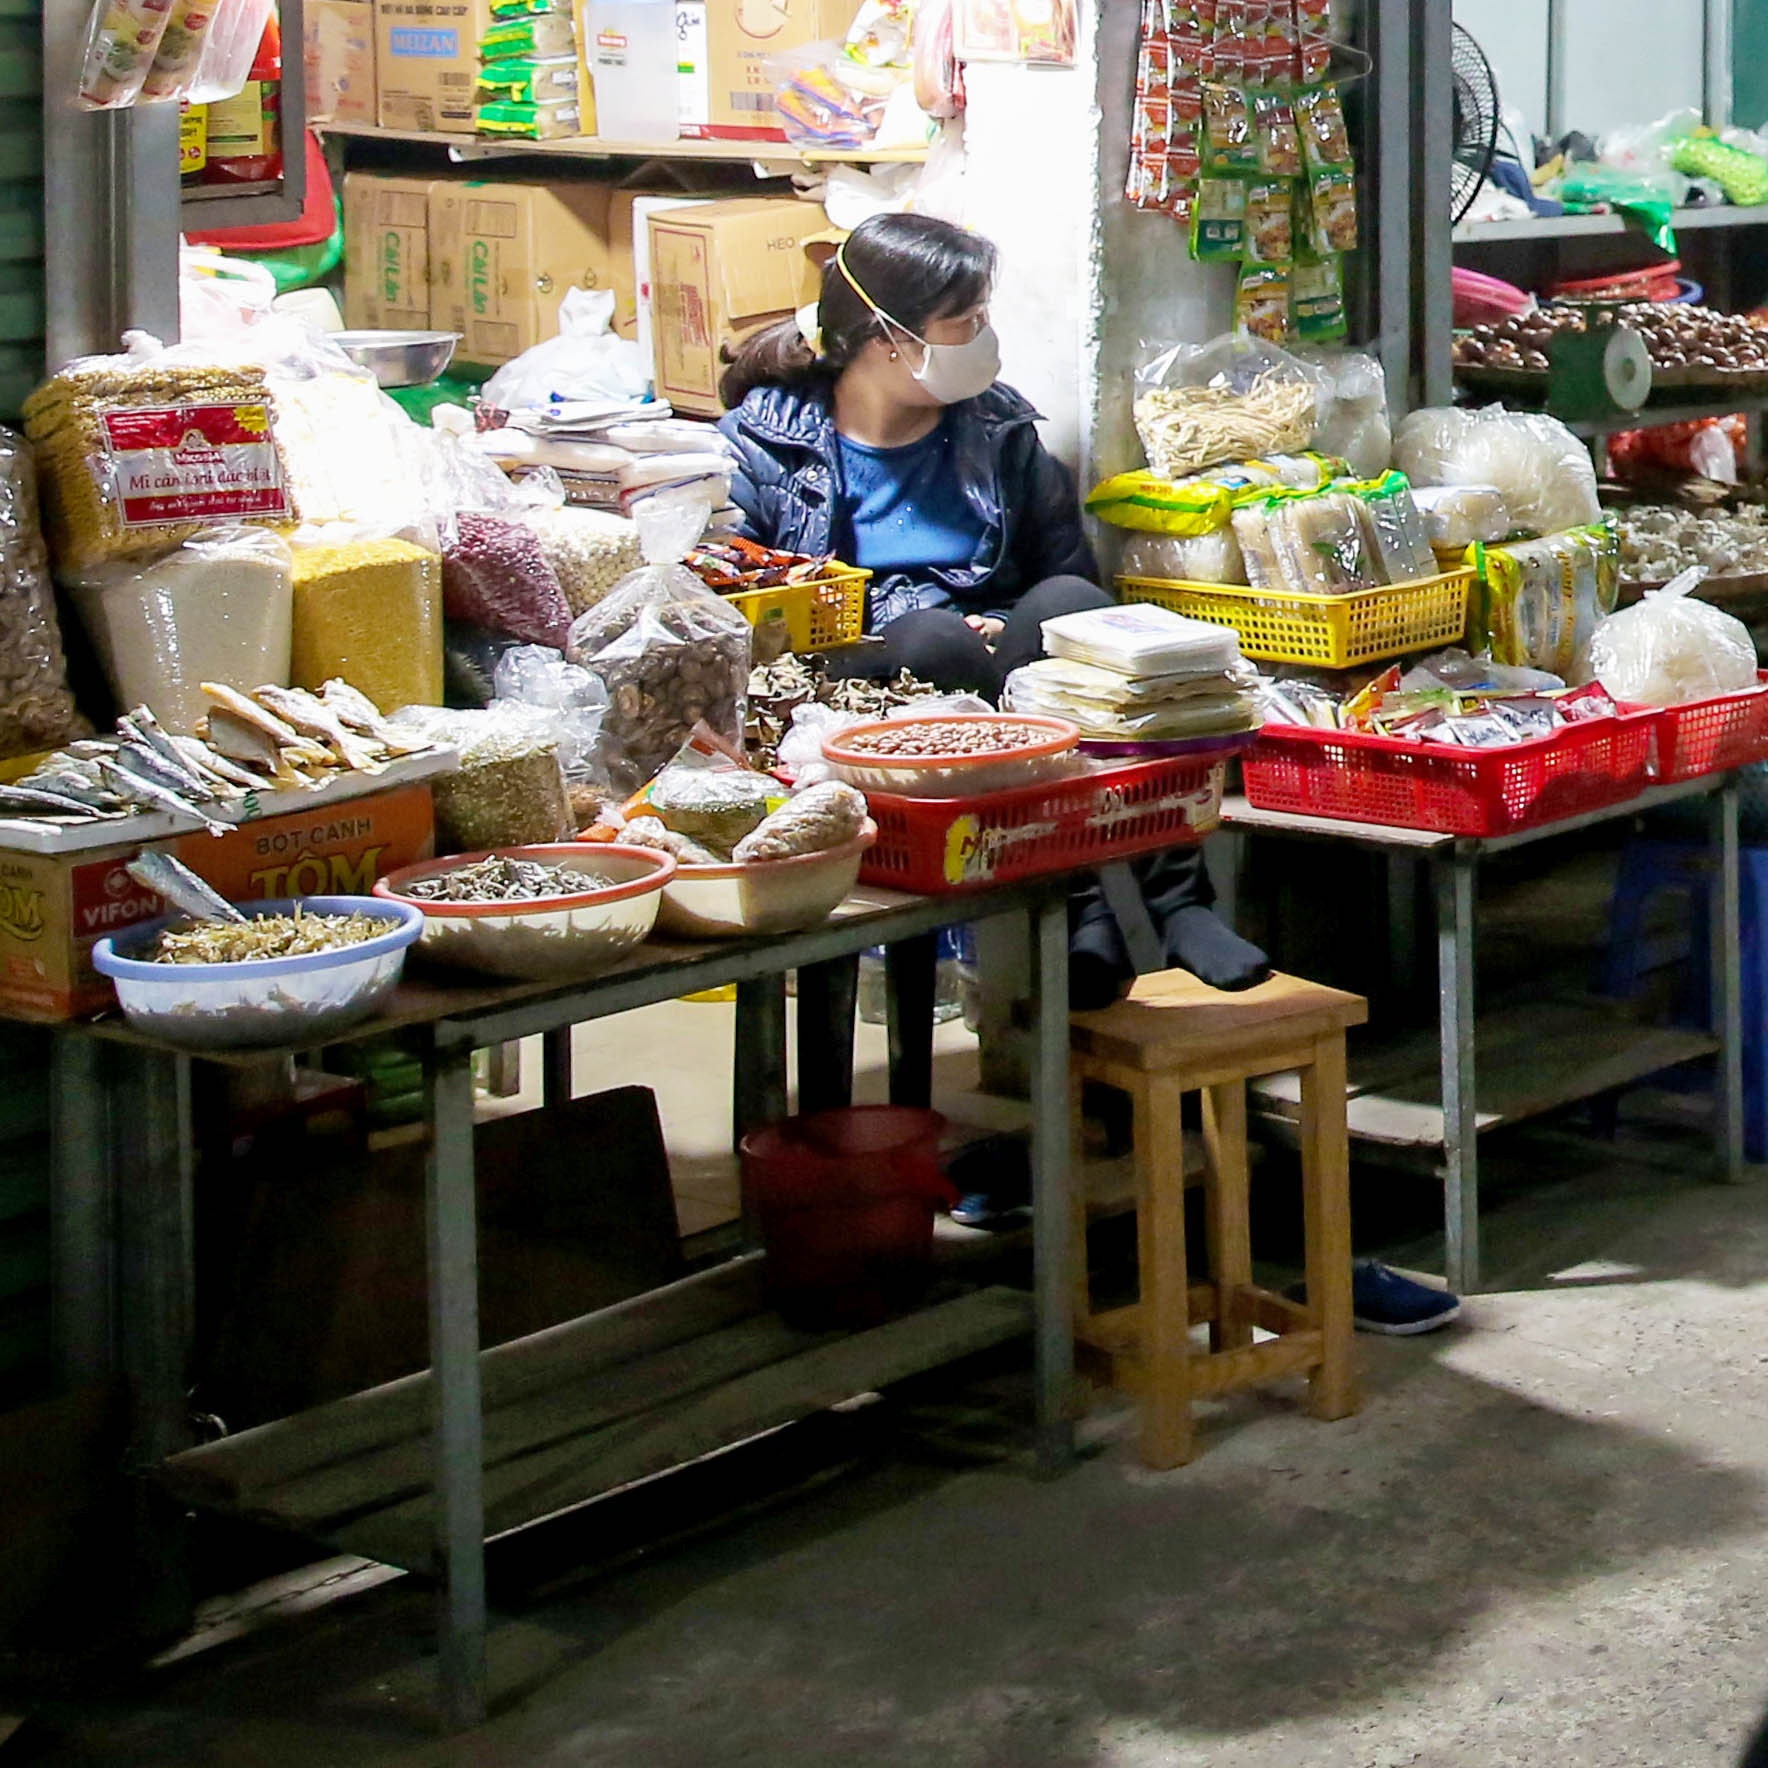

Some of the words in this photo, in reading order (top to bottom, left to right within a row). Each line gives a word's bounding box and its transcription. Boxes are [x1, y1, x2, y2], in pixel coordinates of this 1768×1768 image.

[766, 236, 796, 252] HEO
[310, 819, 373, 848] CANH
[250, 844, 392, 900] TÔM
[83, 896, 159, 928] VIFON
